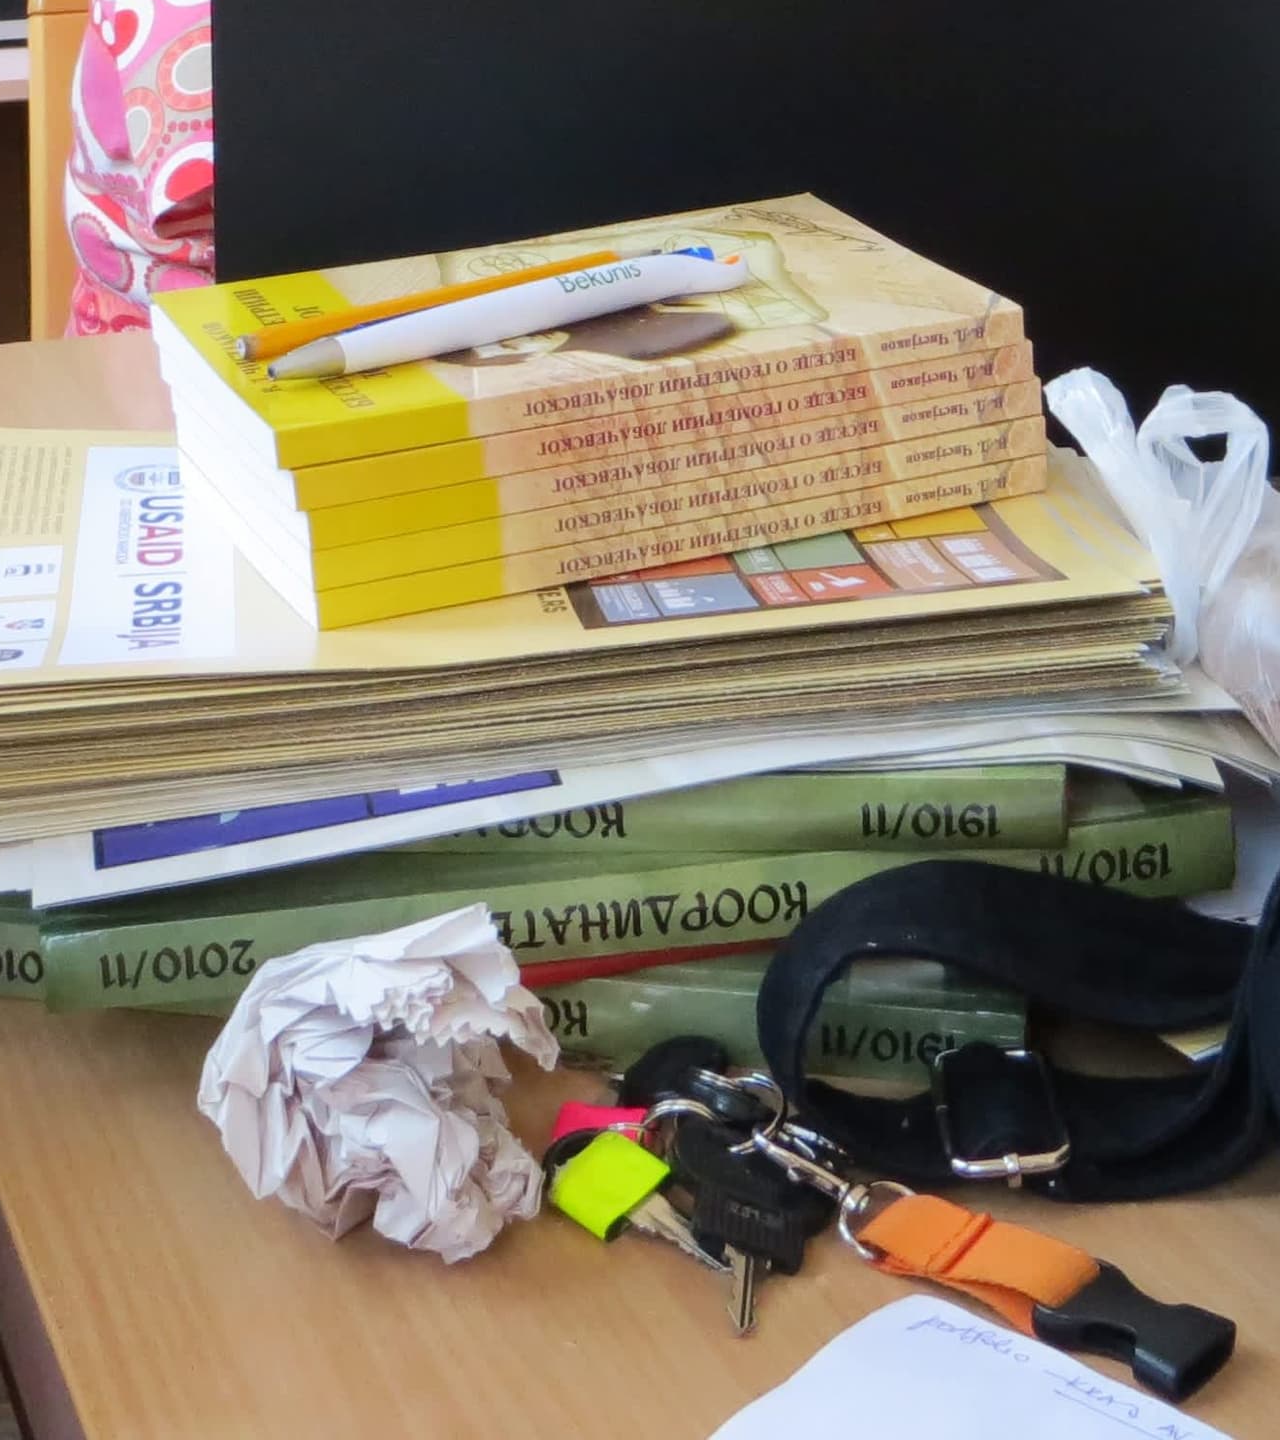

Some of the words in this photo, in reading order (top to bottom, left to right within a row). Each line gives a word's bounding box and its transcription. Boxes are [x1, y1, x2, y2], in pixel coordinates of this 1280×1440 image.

[556, 260, 641, 293] Bekunis
[881, 333, 949, 351] Чистјаков
[776, 361, 788, 373] О
[793, 348, 856, 371] БЕСЕДЕ
[659, 364, 770, 392] ГЕОМЕТРИЈИ
[891, 370, 958, 389] Чистјаков
[523, 384, 654, 416] ЛОБАЧЕВСКОГ
[787, 399, 799, 411] О
[804, 386, 867, 408] БЕСЕДЕ
[672, 401, 782, 433] ГЕОМЕТРИЈИ
[902, 403, 968, 423] Чистјаков
[537, 422, 667, 456] ЛОБАЧЕВСКОГ
[800, 434, 812, 446] О
[816, 420, 878, 442] БЕСЕДЕ
[686, 435, 795, 467] ГЕОМЕТРИЈИ
[906, 444, 972, 464] Чистјаков
[552, 457, 680, 493] ЛОБАЧЕВСКОГ
[803, 474, 815, 486] О
[822, 461, 882, 483] БЕСЕДЕ
[688, 476, 798, 508] ГЕОМЕТРИЈИ
[906, 484, 972, 503] Чистјаков
[555, 497, 683, 533] ЛОБАЧЕВСКОГ
[803, 514, 815, 527] О
[821, 501, 882, 524] БЕСЕДЕ
[136, 495, 184, 566] USAID
[689, 517, 799, 549] ГЕОМЕТРИЈИ
[556, 538, 685, 575] ЛОБАЧЕВСКОГ
[116, 581, 183, 651] SRBIJA
[860, 802, 1000, 839] 1910/11
[100, 939, 256, 990] 2010/11
